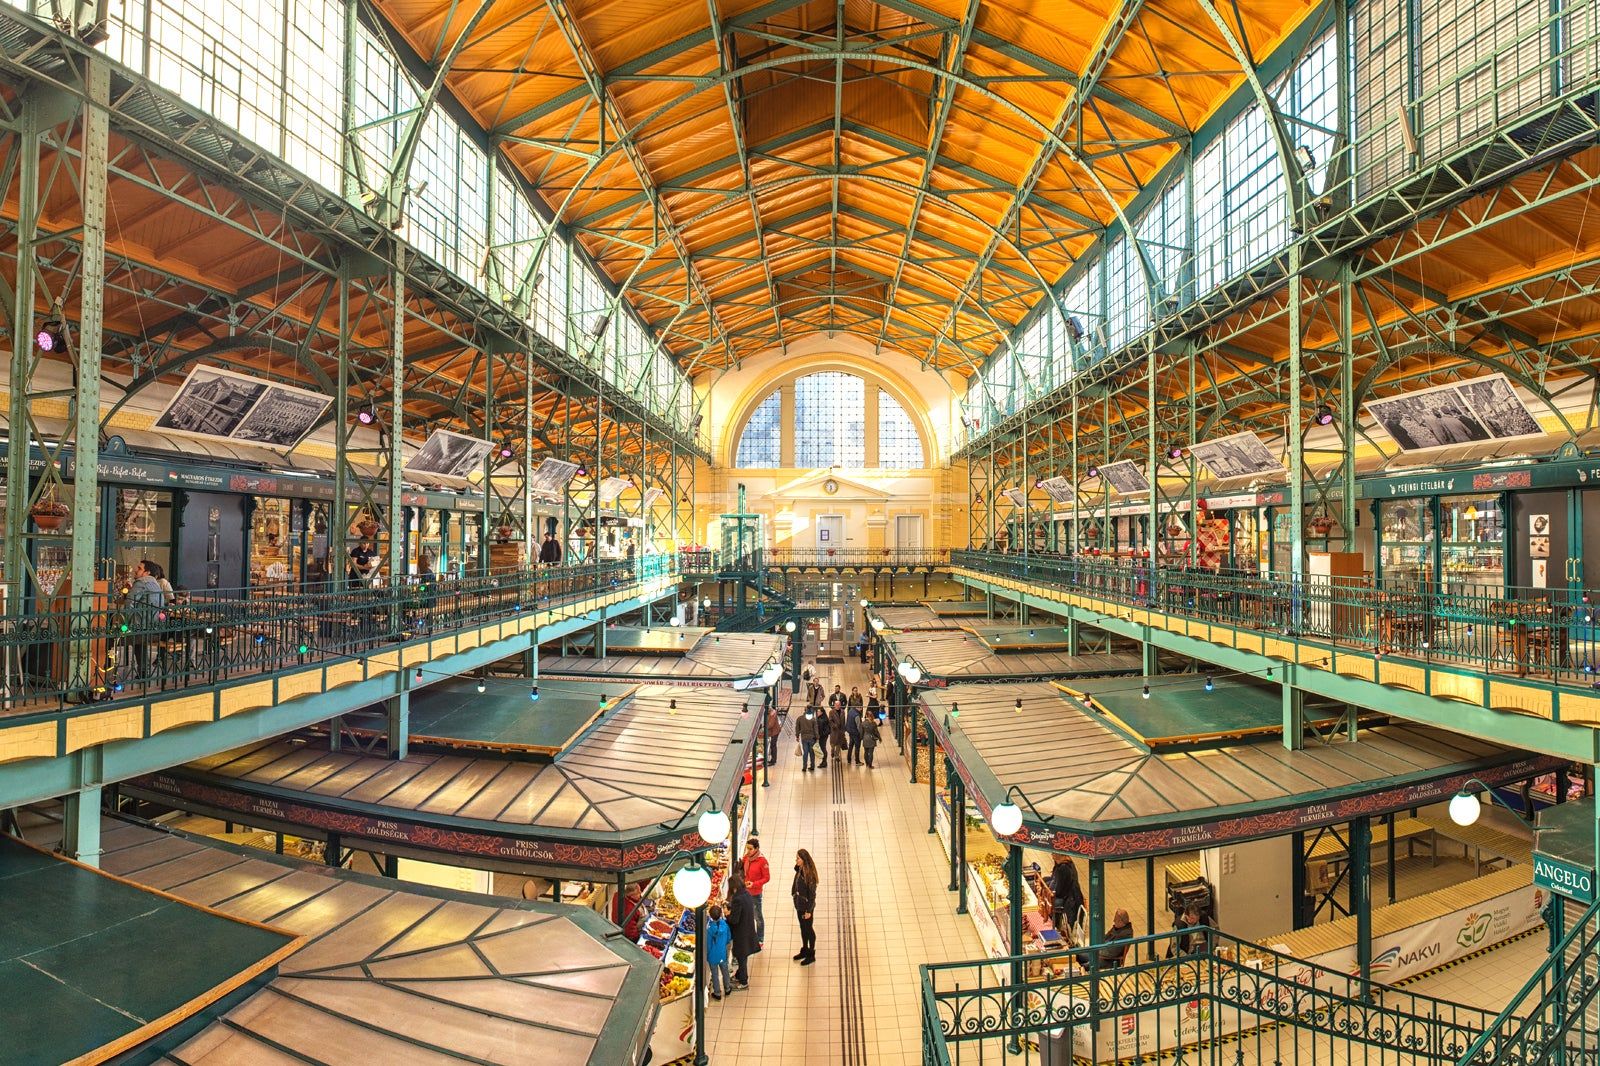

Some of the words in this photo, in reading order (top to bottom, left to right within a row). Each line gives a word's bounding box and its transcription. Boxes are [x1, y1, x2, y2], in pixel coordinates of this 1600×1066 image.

[1417, 782, 1434, 792] FRISS
[377, 820, 398, 831] FRISS
[1181, 825, 1204, 836] HAZAI
[366, 826, 409, 840] ZÖLDSÉGEK
[1172, 830, 1213, 845] TERMELŐK
[515, 840, 539, 850] FRISS
[500, 846, 554, 860] GYÜMÖLCSÖK
[1534, 861, 1591, 892] ANGELO
[1397, 942, 1441, 969] NAKVI
